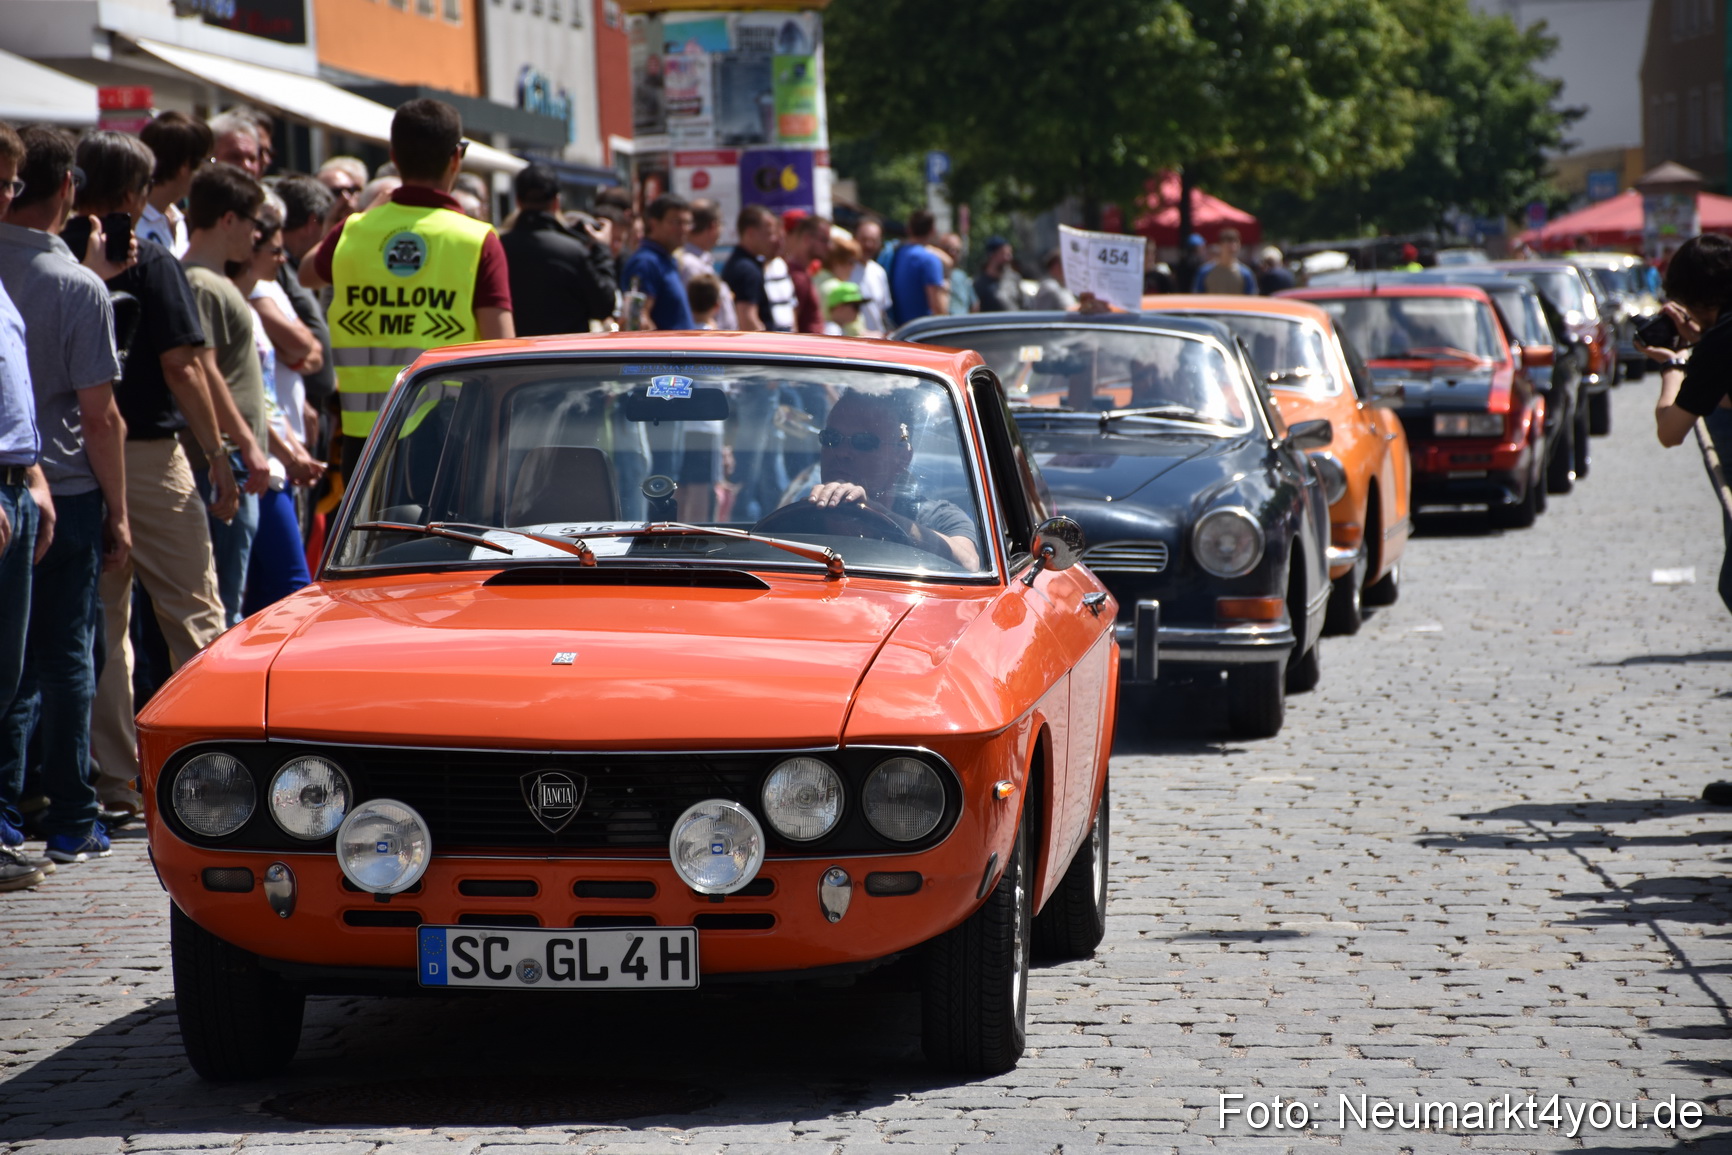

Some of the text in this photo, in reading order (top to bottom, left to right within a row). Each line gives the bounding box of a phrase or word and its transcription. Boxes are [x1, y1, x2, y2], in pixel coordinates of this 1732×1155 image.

[1097, 247, 1129, 265] 454
[346, 285, 457, 311] FOLLOW
[379, 313, 417, 335] ME
[559, 525, 614, 534] 516
[543, 785, 572, 806] LANCIA
[428, 962, 439, 976] D
[451, 935, 512, 980] SC
[546, 937, 609, 982] GL
